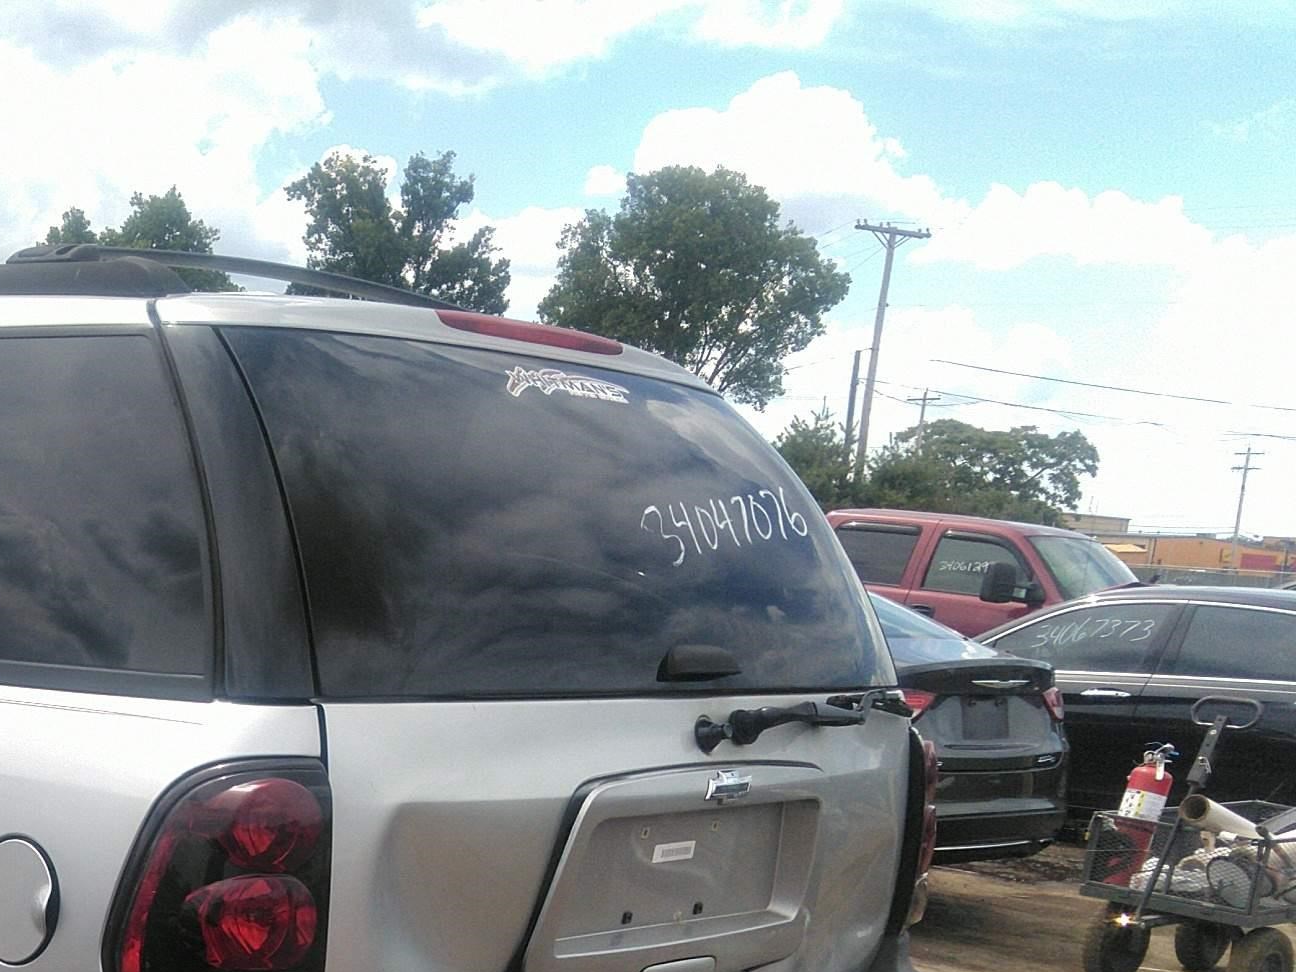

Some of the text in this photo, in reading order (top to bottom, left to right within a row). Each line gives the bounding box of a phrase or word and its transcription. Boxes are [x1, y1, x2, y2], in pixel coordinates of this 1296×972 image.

[640, 486, 808, 567] 34047076
[938, 560, 995, 573] 3406129
[1031, 616, 1156, 648] 34067373
